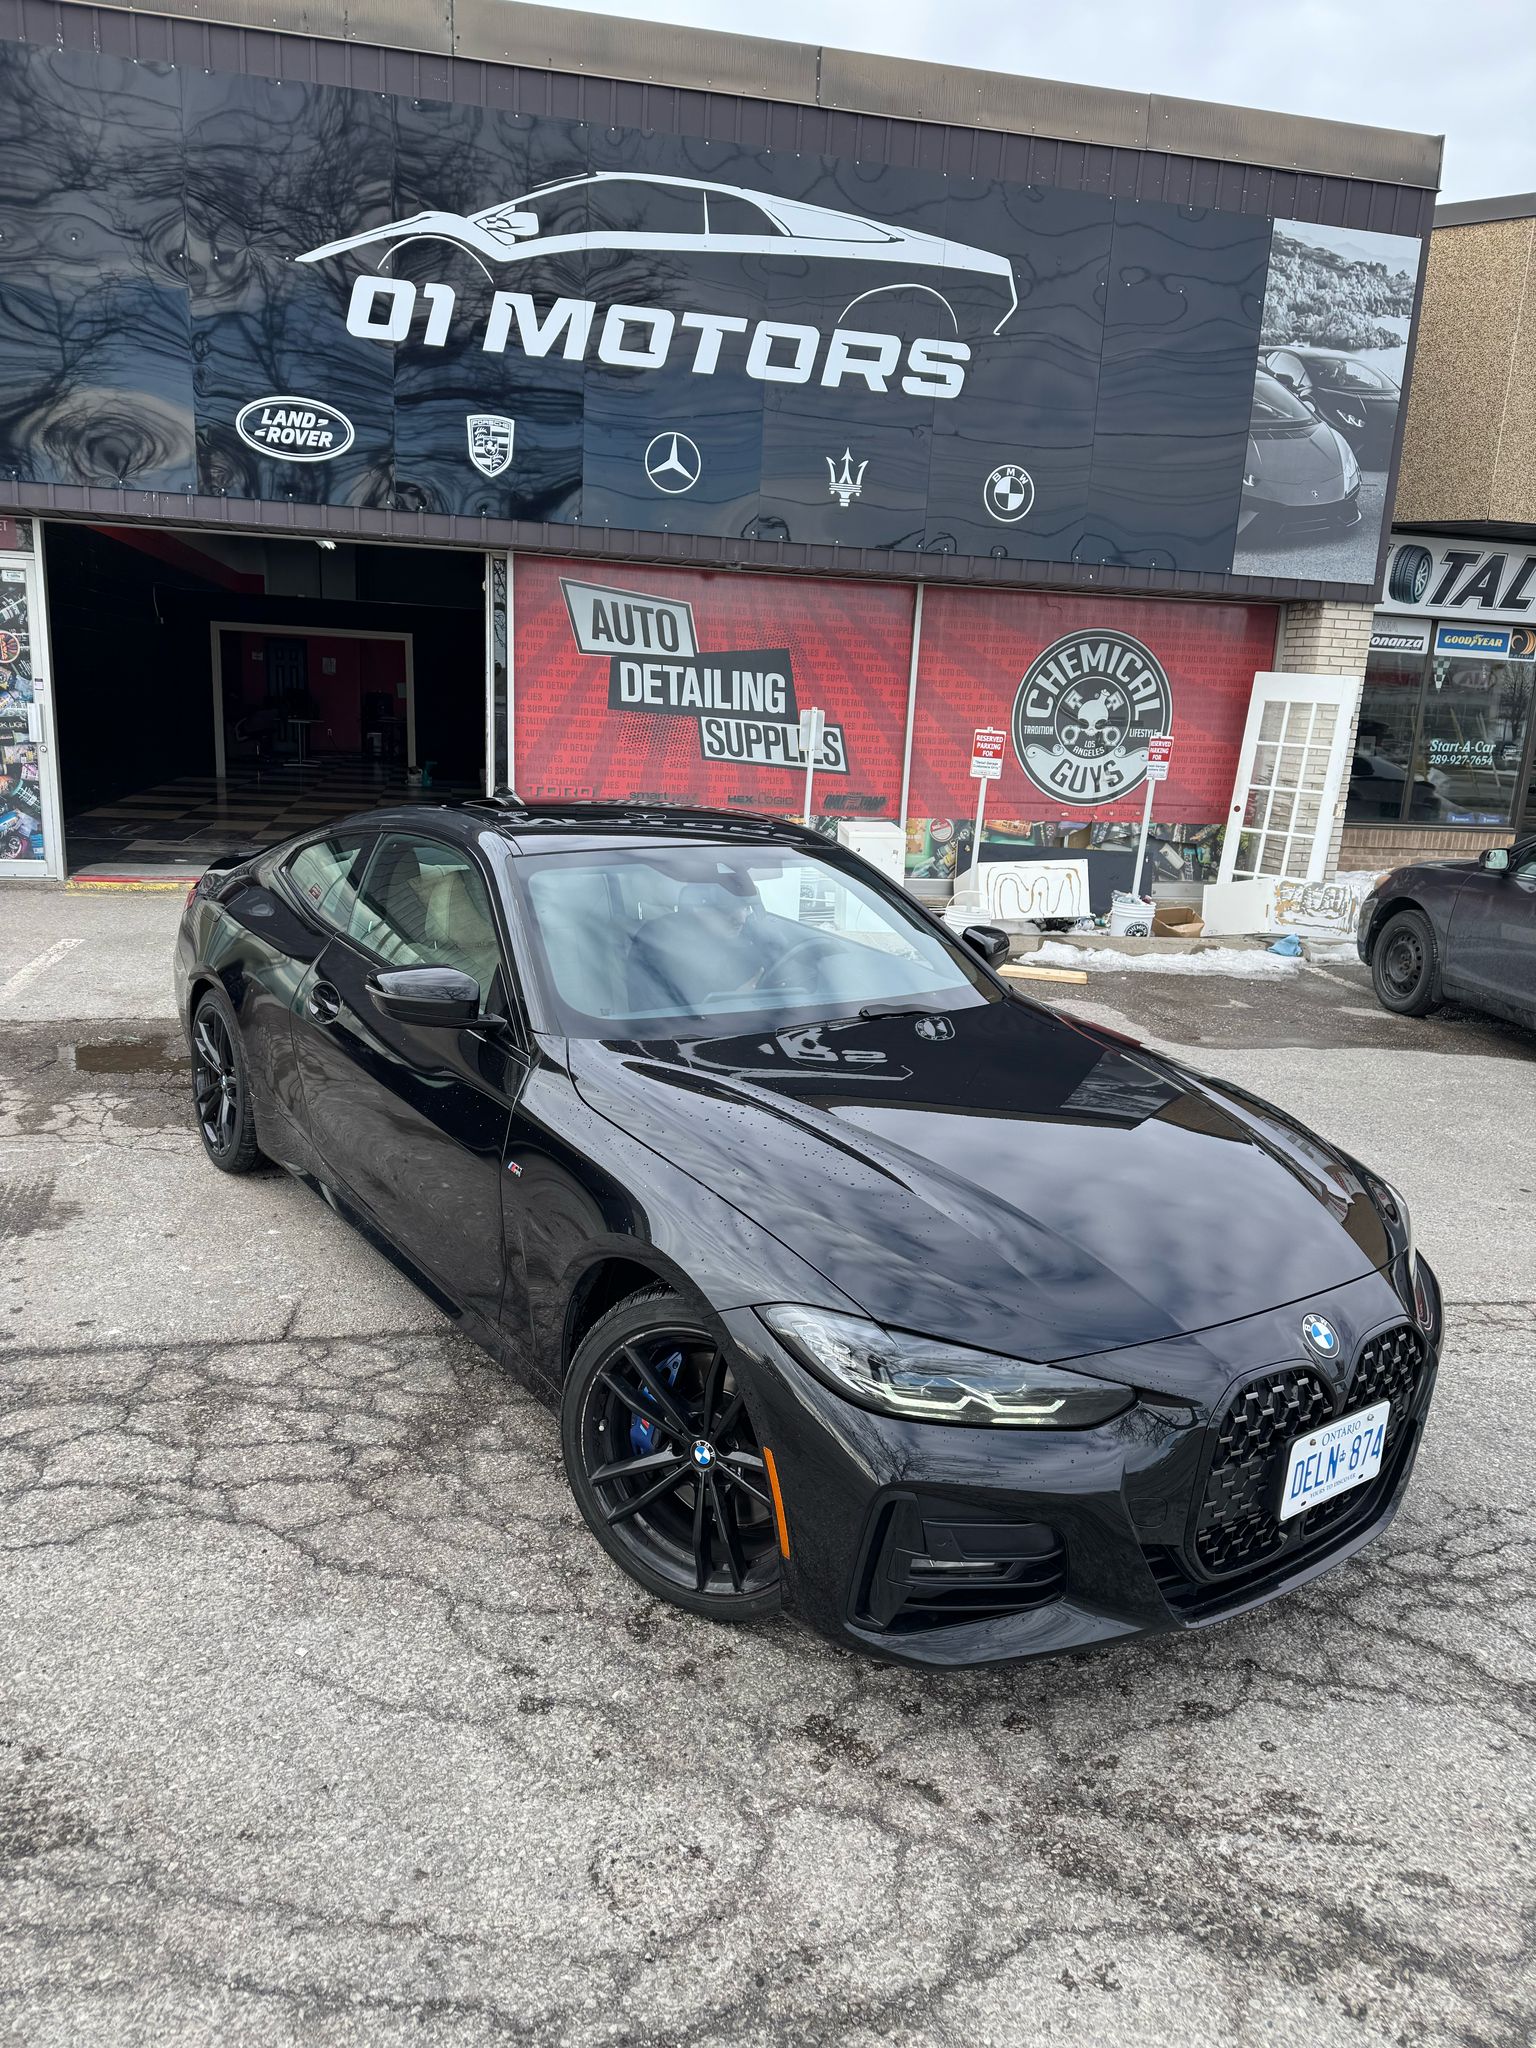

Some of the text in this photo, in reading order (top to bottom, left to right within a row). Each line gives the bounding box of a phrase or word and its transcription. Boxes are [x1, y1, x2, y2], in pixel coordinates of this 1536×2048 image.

[346, 275, 971, 399] 01 MOTORS
[261, 409, 317, 431] LAND
[266, 427, 333, 448] ROVER
[992, 468, 1029, 485] BMW
[592, 598, 679, 653] AUTO
[1370, 636, 1424, 648] onanza
[1444, 635, 1503, 648] GOODYEAR
[620, 660, 786, 714] DETAILING
[1026, 643, 1161, 721] CHEMICAL
[1024, 725, 1053, 735] TRADITION
[706, 719, 841, 767] SUPPLS
[976, 735, 1004, 743] RESERVED
[976, 742, 1001, 750] PARKING
[1084, 740, 1096, 748] LOS
[1429, 740, 1496, 753] Start-A-Car
[1072, 746, 1105, 757] ANGELES
[1429, 754, 1493, 766] 289-927-7654
[1050, 758, 1124, 794] GUYS
[629, 792, 667, 800] smart
[1321, 1420, 1361, 1446] ONTARIO
[1290, 1424, 1384, 1499] DELN 874
